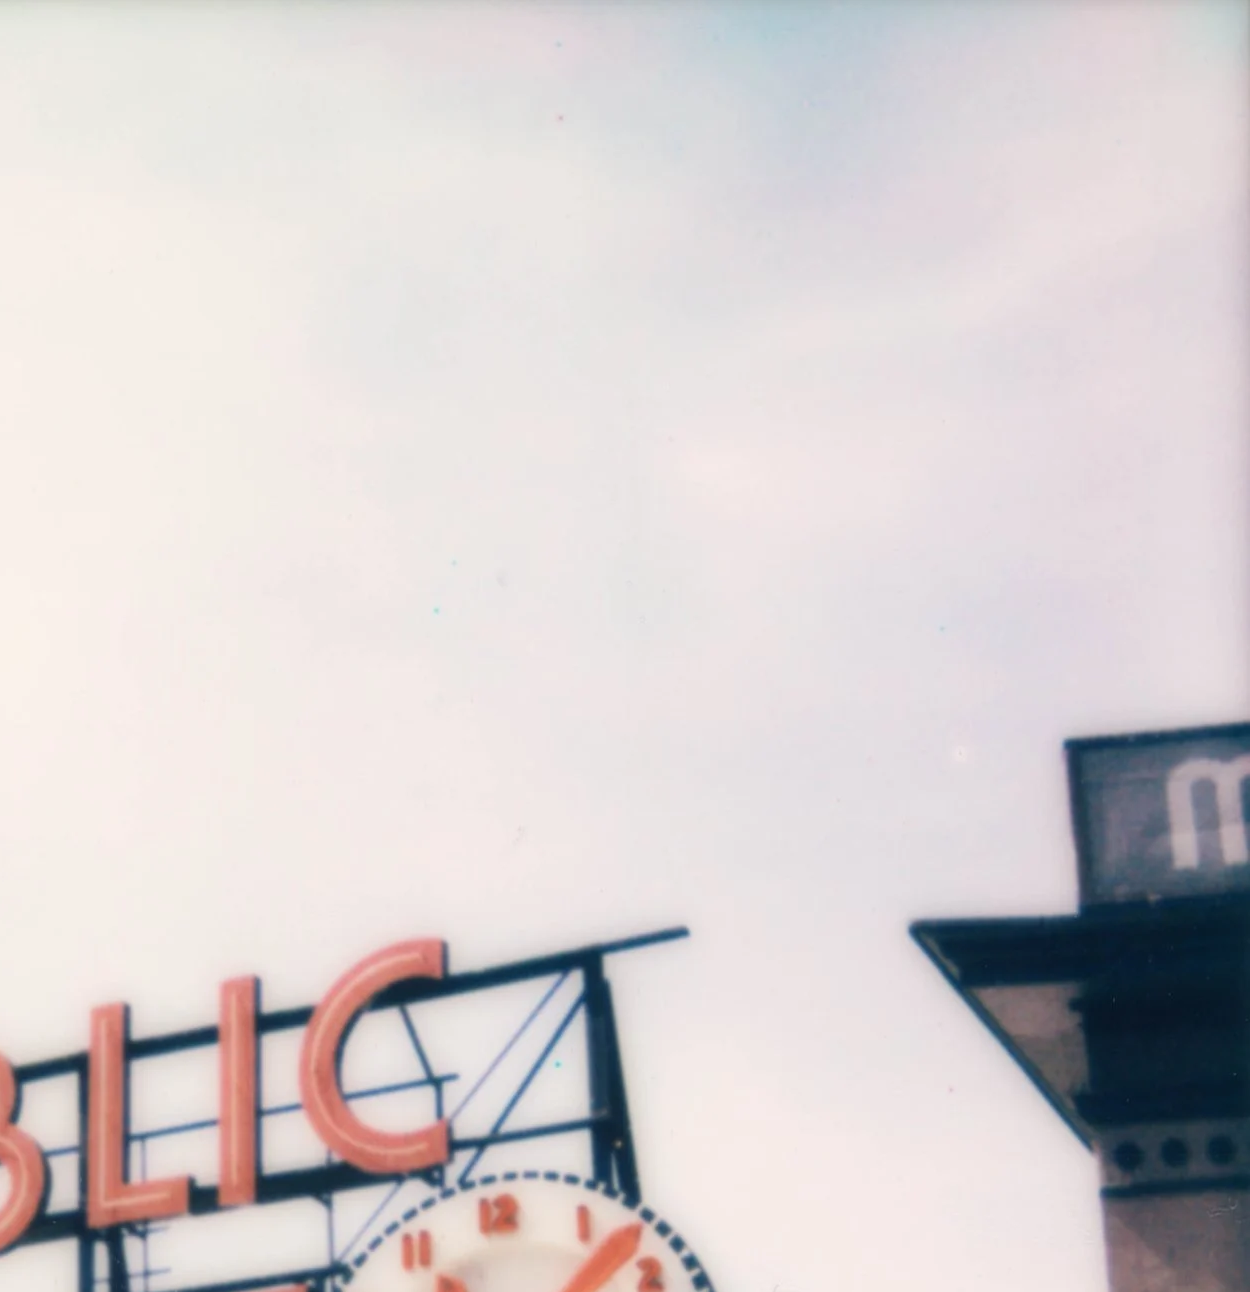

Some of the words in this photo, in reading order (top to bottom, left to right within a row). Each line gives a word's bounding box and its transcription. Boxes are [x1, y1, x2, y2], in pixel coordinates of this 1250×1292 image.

[478, 1193, 520, 1236] 12
[576, 1204, 592, 1244] 1
[401, 1229, 432, 1272] 11
